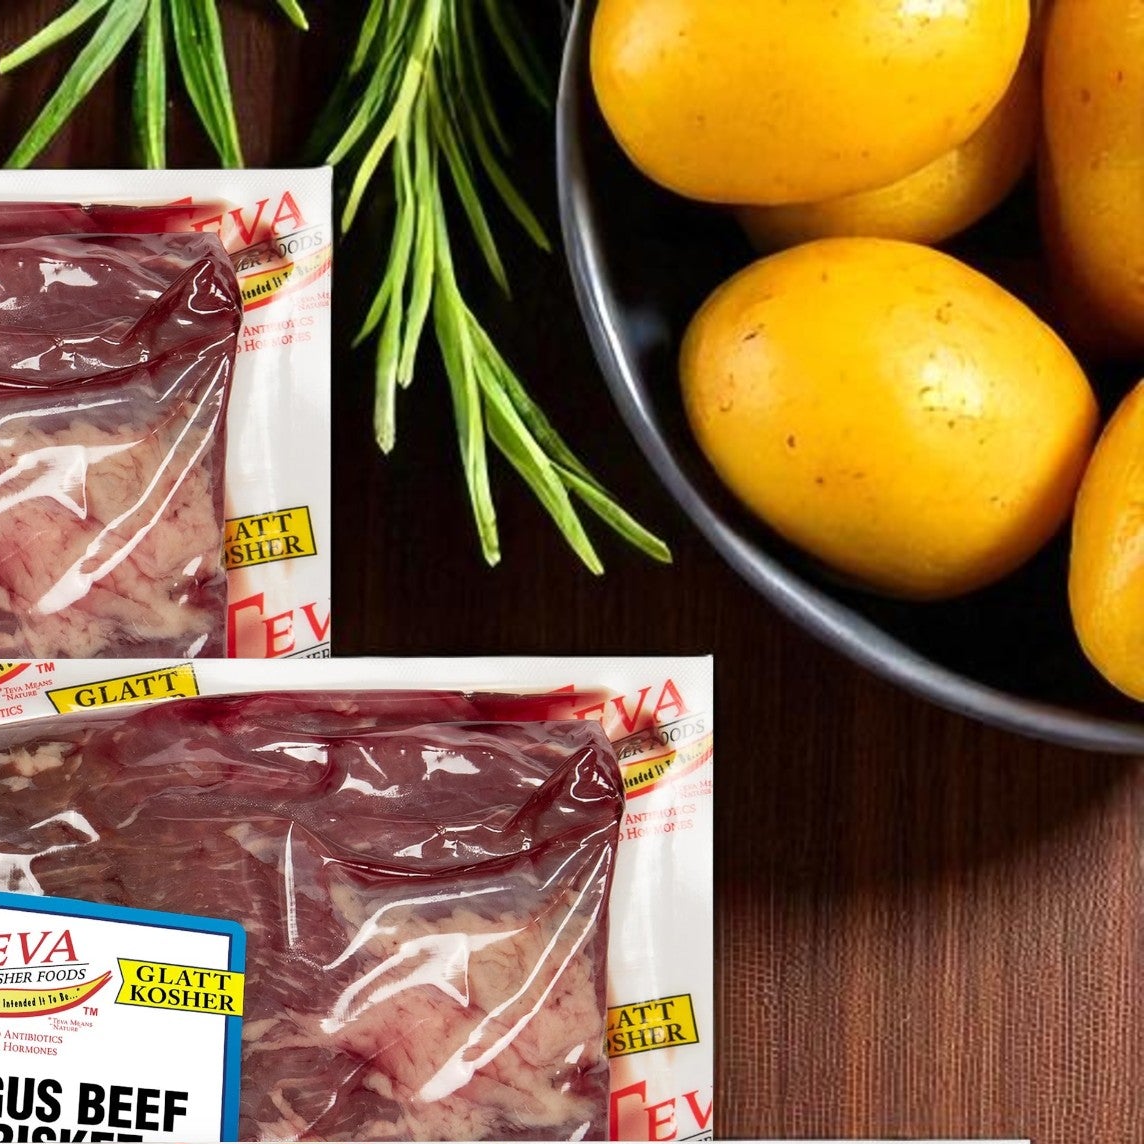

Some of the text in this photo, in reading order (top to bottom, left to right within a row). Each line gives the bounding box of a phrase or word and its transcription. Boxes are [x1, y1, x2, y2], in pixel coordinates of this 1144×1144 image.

[75, 670, 180, 707] GLATT
[36, 969, 87, 983] FOODS
[137, 965, 233, 991] GLATT
[3, 995, 37, 1008] Intended
[130, 984, 235, 1013] KOSHER
[83, 1006, 99, 1016] TM
[5, 1030, 64, 1044] ANTIBIOTICS
[4, 1042, 58, 1056] HORMONES
[78, 1082, 189, 1133] BEEF
